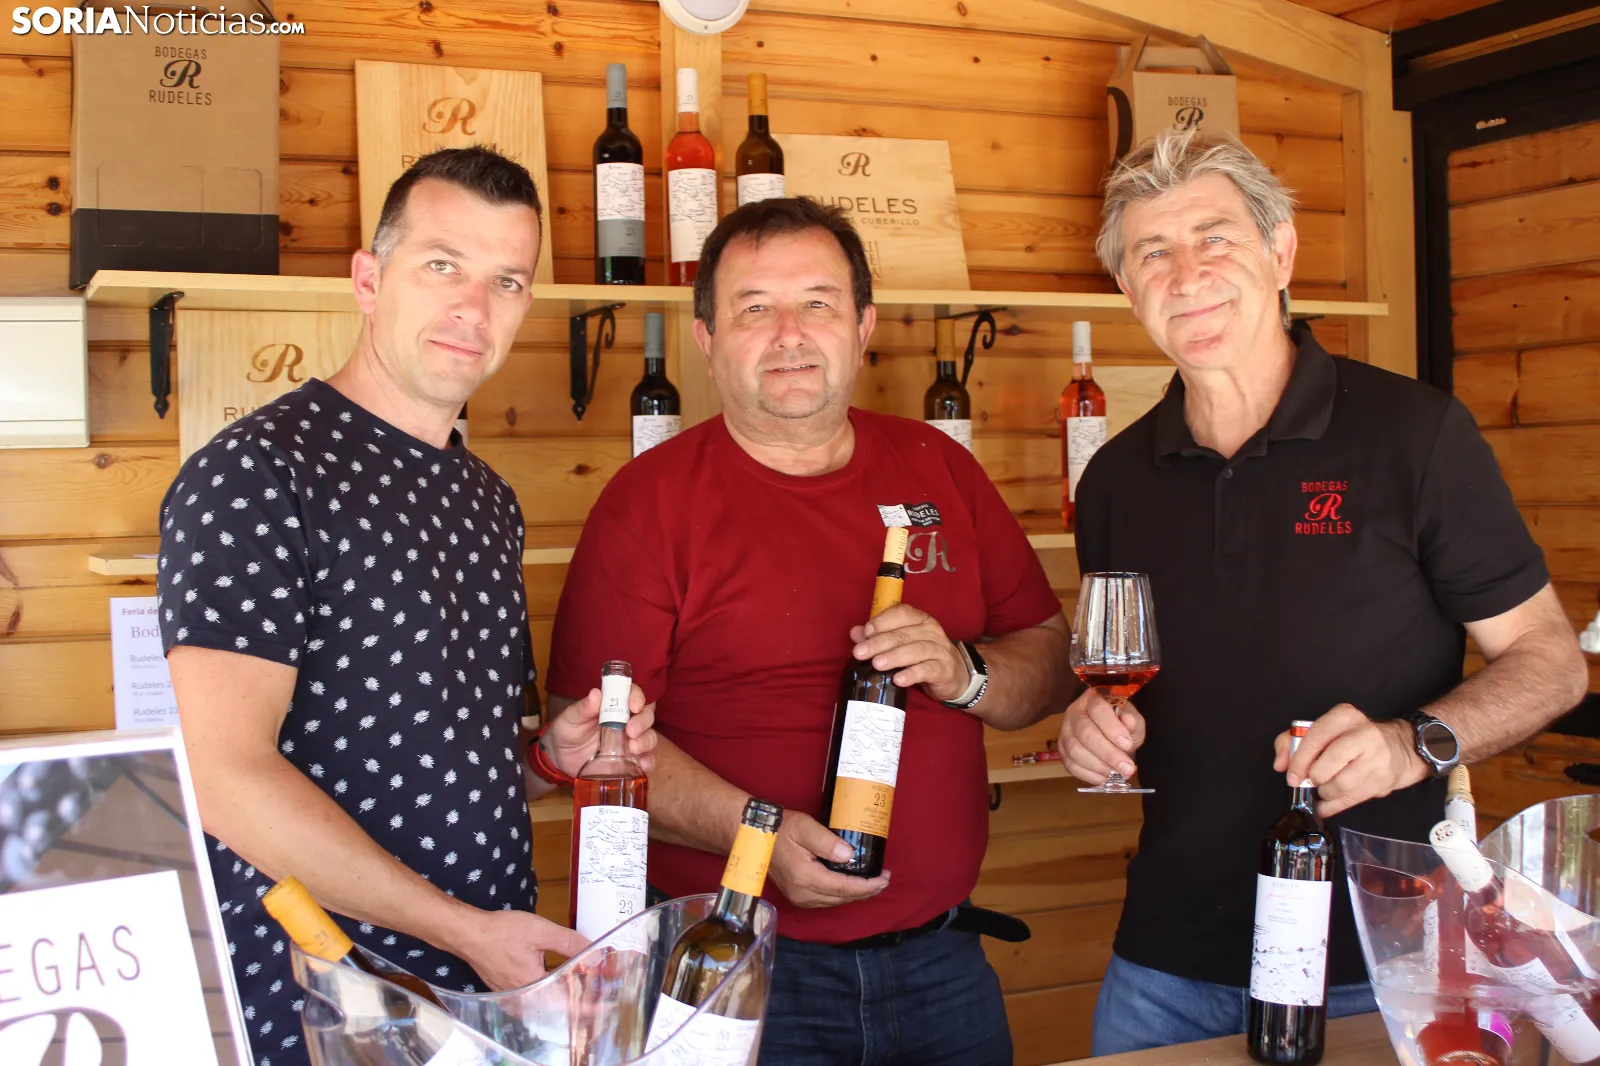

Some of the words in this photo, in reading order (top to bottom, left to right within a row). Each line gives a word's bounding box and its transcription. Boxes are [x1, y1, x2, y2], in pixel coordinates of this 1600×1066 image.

[154, 46, 208, 60] BODEGAS
[159, 59, 202, 89] R
[149, 90, 212, 106] RUDELES
[1167, 96, 1208, 107] BODEGAS
[422, 96, 477, 136] R
[838, 151, 872, 177] R
[245, 343, 304, 383] R
[1301, 480, 1349, 493] BODEGAS
[1304, 493, 1343, 521] R
[1295, 520, 1353, 535] RUDELES
[904, 531, 957, 574] R
[122, 607, 146, 616] Feria
[132, 681, 165, 690] Rudeles
[609, 697, 620, 707] 23
[133, 707, 167, 716] Rudeles
[873, 792, 887, 808] 23
[618, 899, 634, 916] 23
[0, 924, 141, 1004] EGAS
